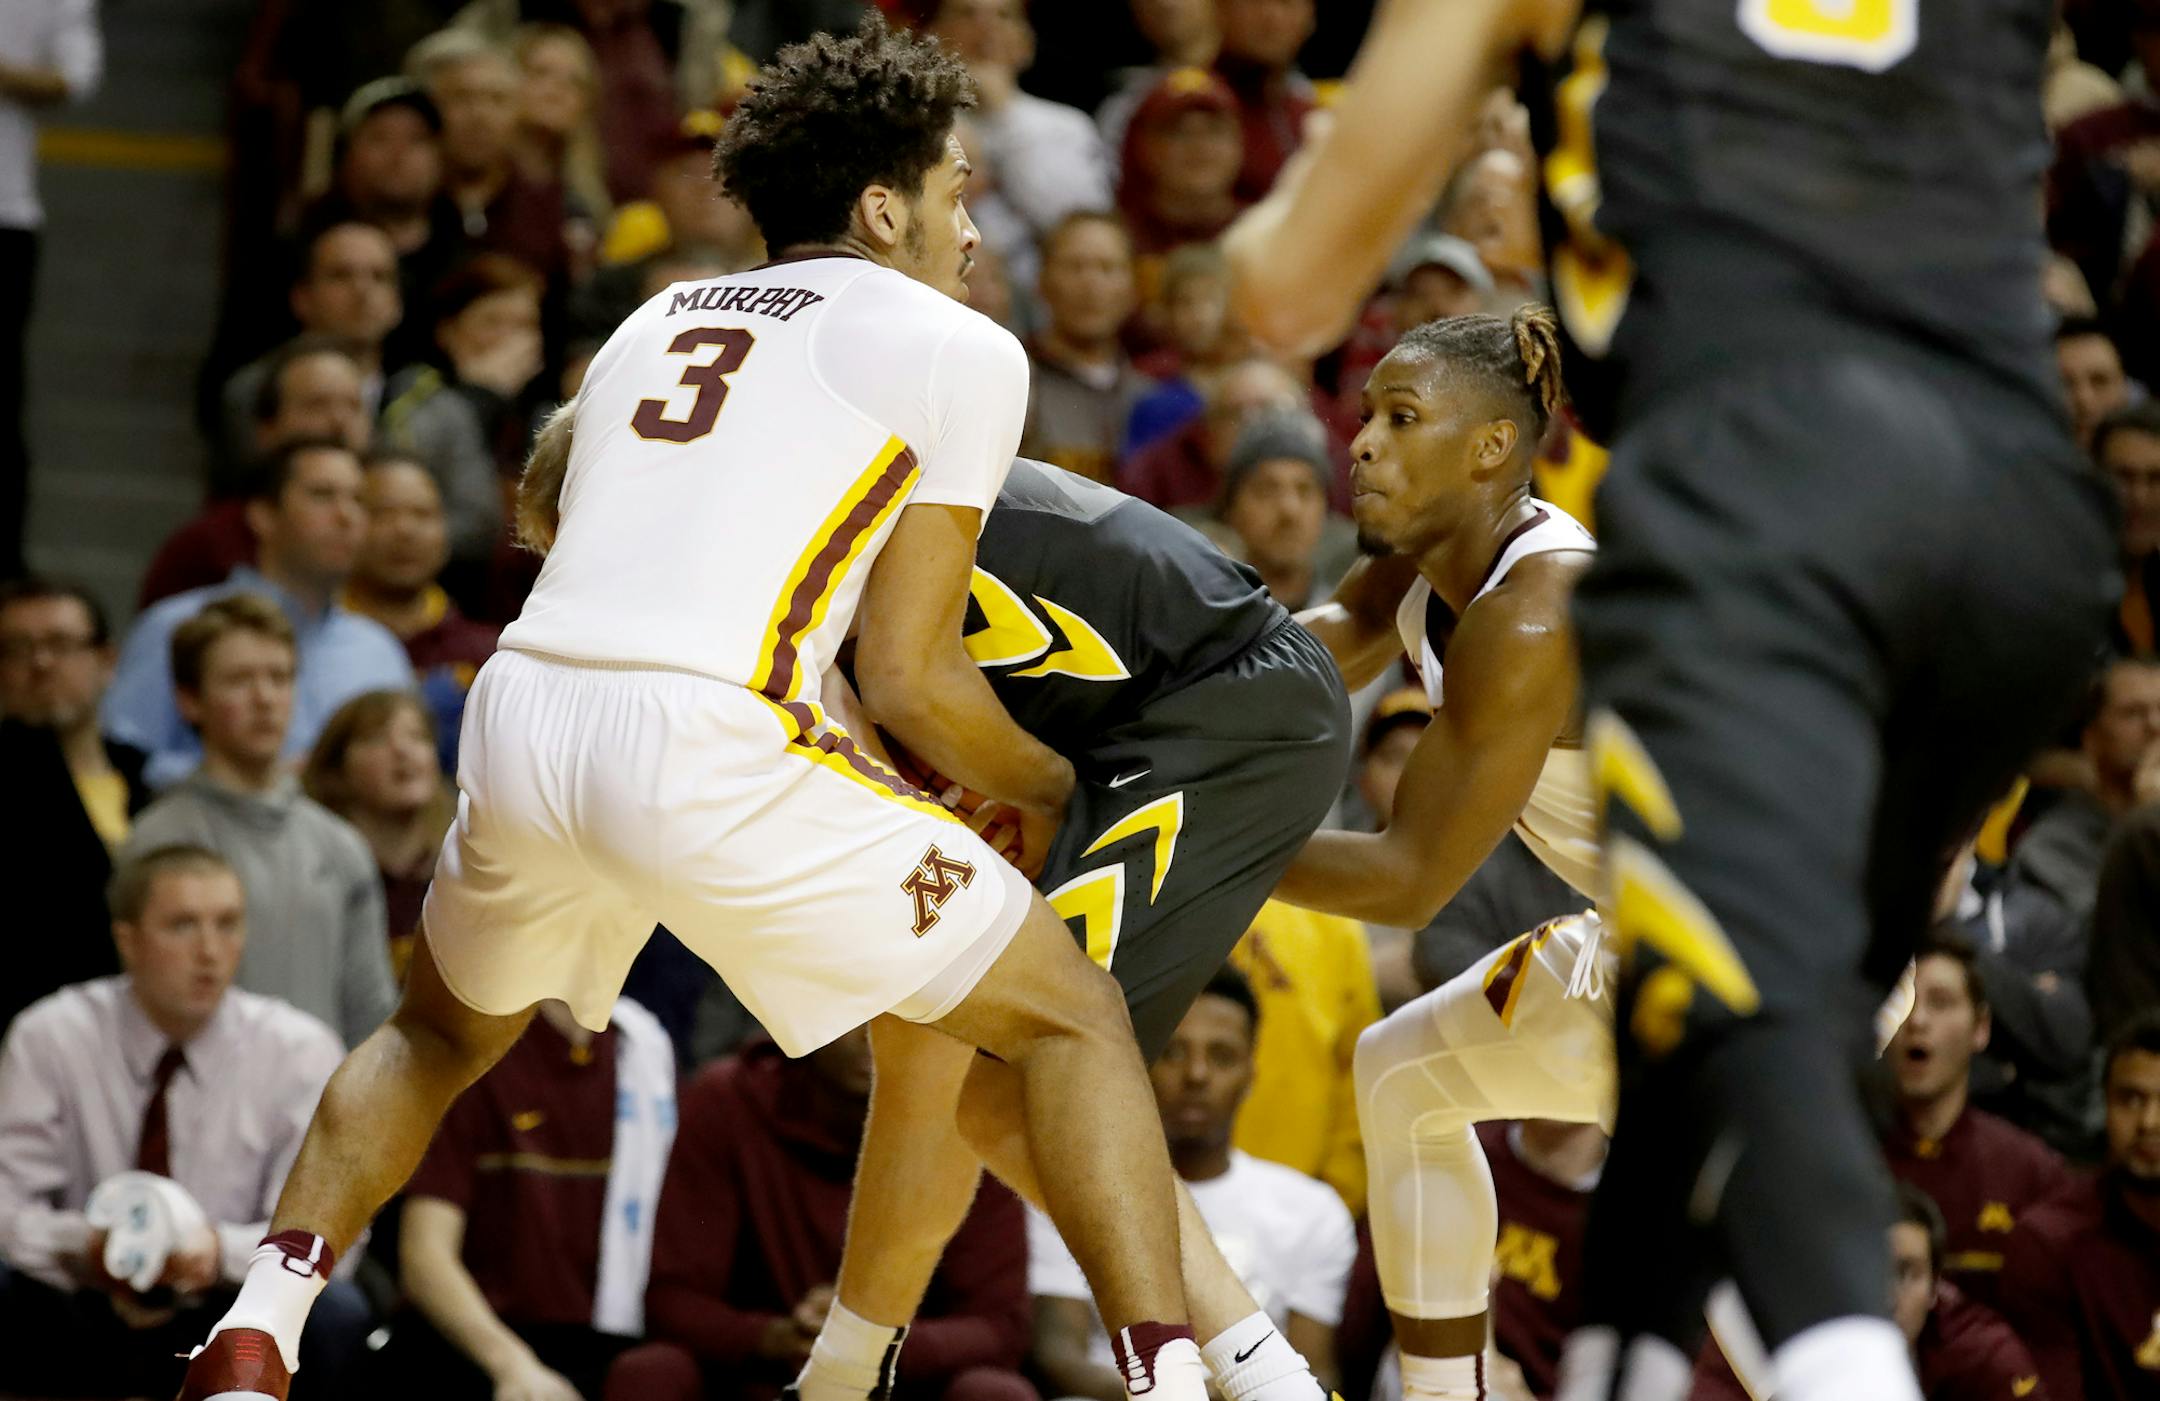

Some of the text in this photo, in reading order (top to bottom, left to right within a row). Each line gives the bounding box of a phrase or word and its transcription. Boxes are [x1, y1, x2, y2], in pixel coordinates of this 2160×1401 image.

[665, 286, 825, 322] MURPHY
[629, 326, 757, 445] 3
[900, 843, 977, 938] M
